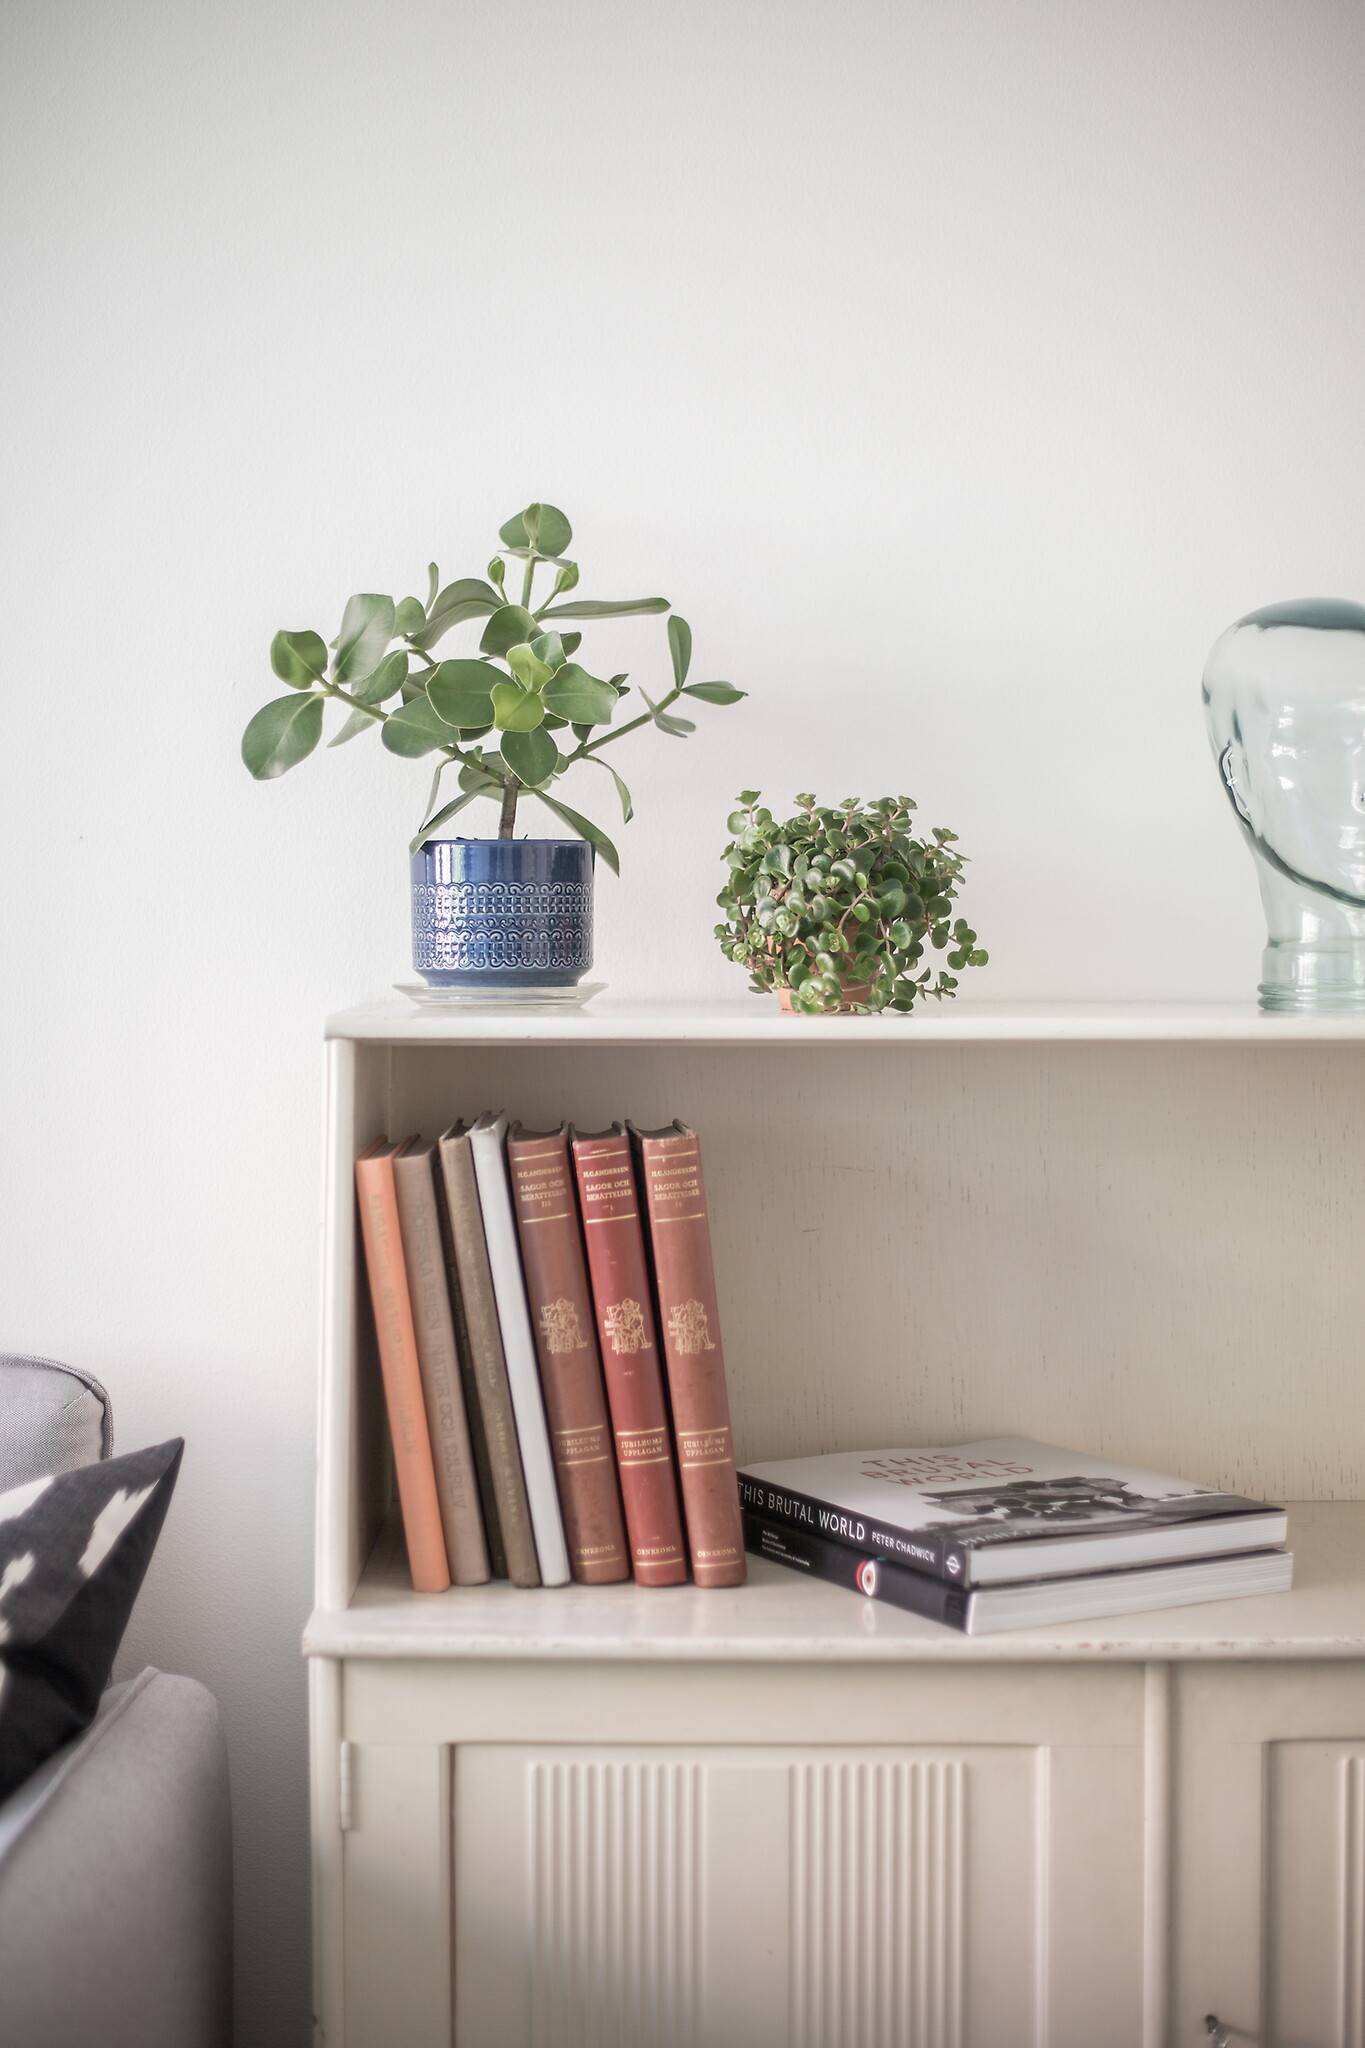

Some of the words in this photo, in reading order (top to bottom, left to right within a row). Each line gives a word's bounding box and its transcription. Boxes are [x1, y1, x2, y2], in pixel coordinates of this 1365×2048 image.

[859, 1459, 1016, 1479] BRUTAL
[861, 1454, 960, 1468] THIS
[886, 1465, 1034, 1486] WORLD
[737, 1482, 764, 1506] THIS
[768, 1492, 814, 1524] BRUTAL
[818, 1509, 865, 1541] WORLD
[871, 1531, 895, 1549] PETER
[896, 1538, 937, 1564] CHADWICK
